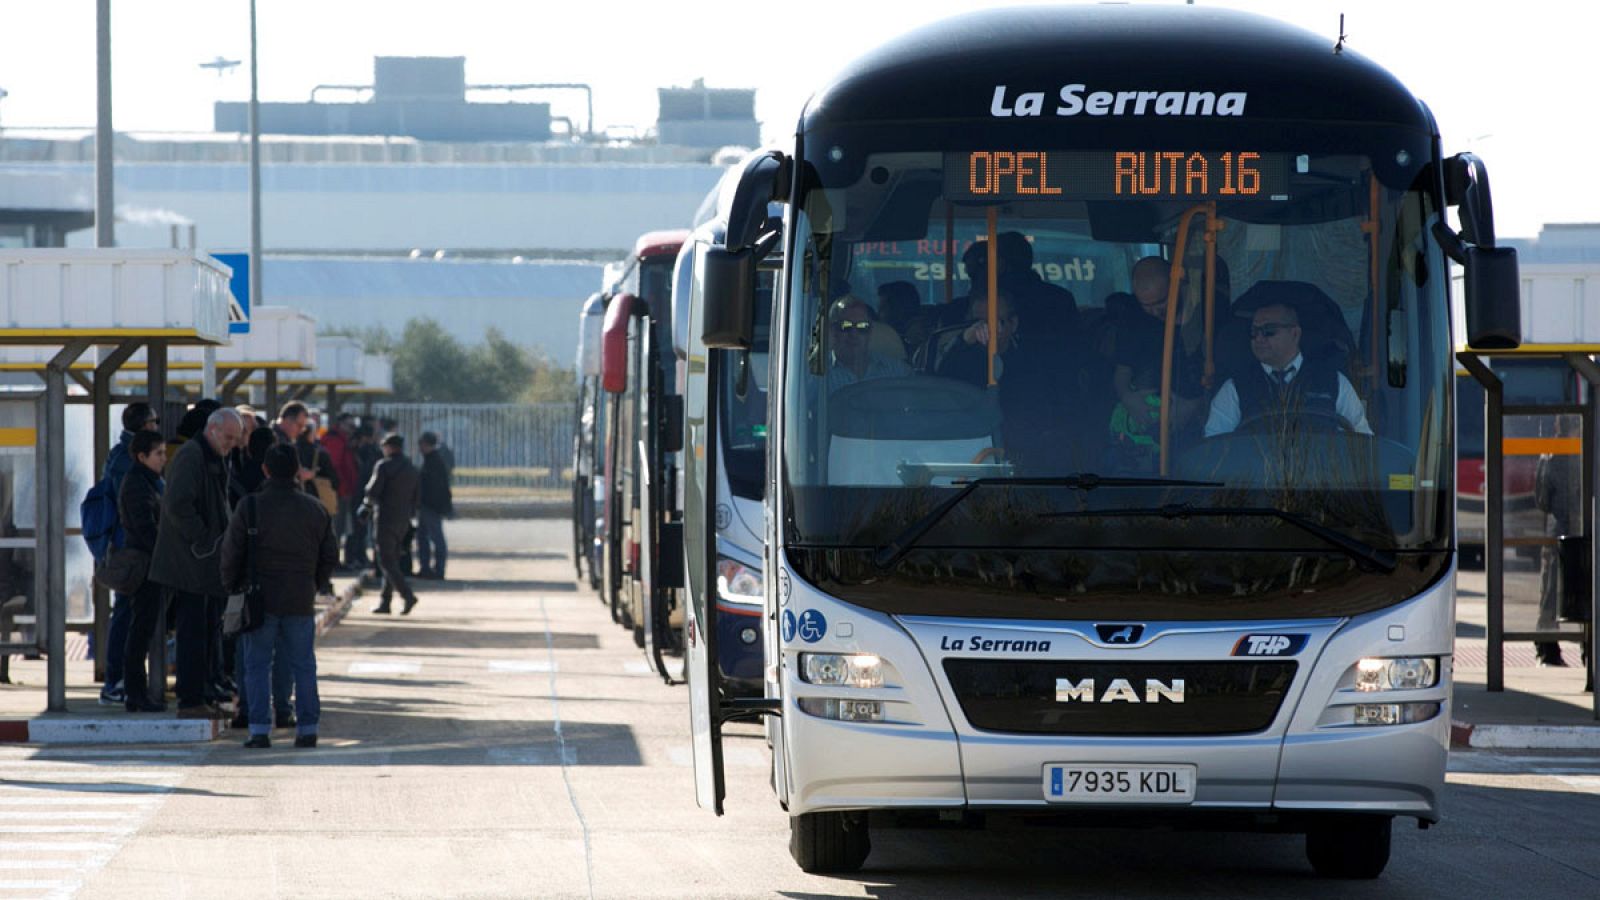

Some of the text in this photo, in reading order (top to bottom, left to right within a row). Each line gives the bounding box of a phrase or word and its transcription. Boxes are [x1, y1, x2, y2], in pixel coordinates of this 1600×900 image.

[991, 84, 1248, 117] La Serrana
[970, 151, 1260, 194] OPEL RUTA 16
[941, 636, 1051, 652] La Serrana
[1055, 678, 1185, 703] MAN
[1068, 771, 1186, 793] 7935 KDL
